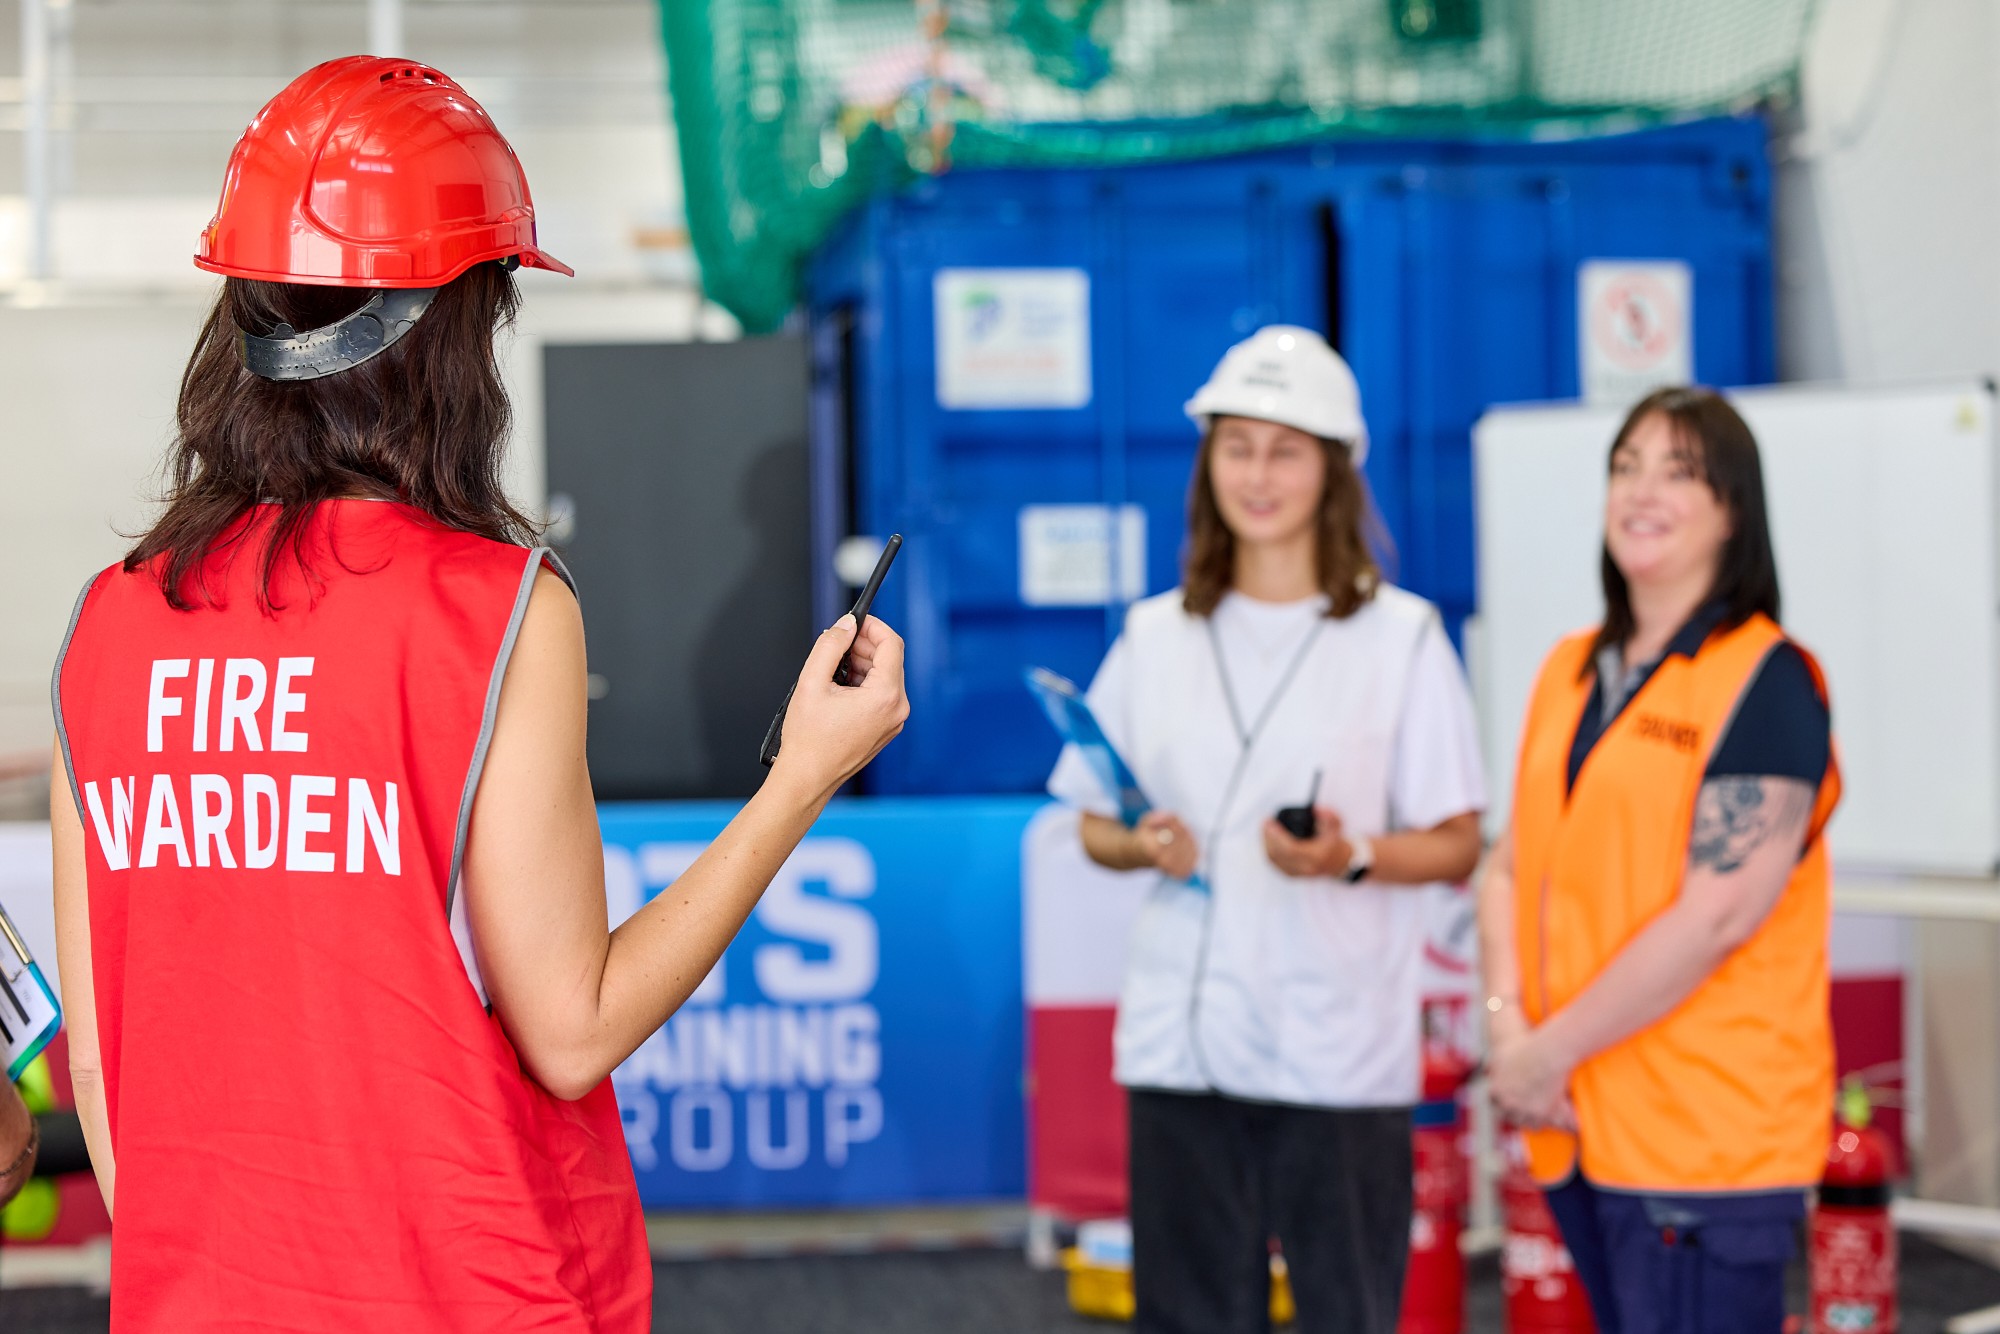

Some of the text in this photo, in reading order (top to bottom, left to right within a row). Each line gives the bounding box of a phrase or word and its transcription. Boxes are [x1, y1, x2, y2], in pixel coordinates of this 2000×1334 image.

[146, 656, 315, 753] FIRE
[84, 773, 402, 877] WARDEN
[610, 1002, 882, 1091] AINING
[612, 1086, 884, 1172] ROUP
